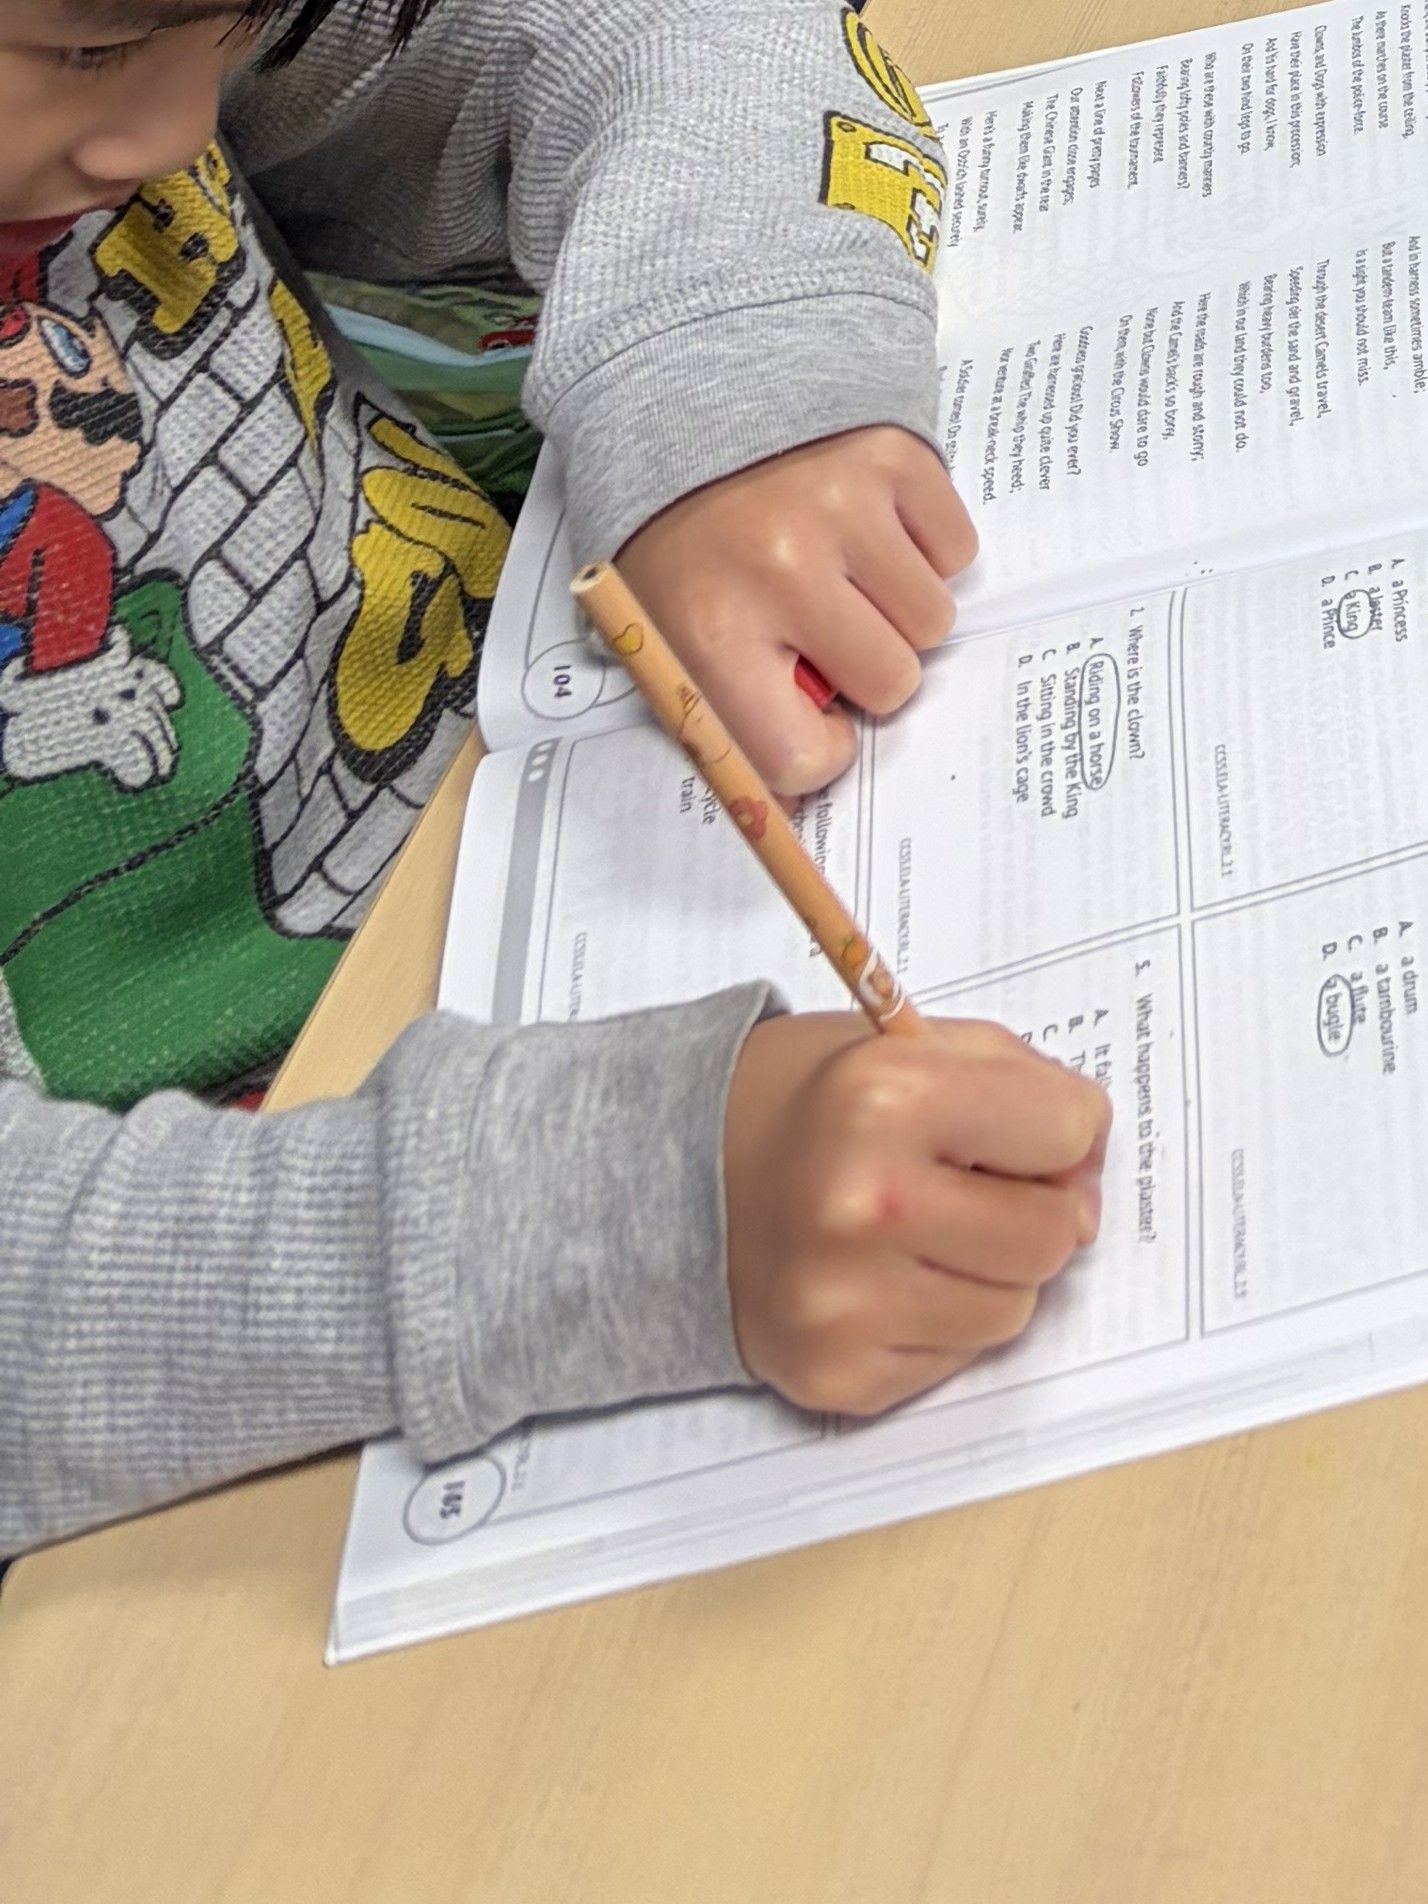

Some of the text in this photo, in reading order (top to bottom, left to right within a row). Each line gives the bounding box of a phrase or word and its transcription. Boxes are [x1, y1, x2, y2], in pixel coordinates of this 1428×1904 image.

[1321, 607, 1339, 649] Prince
[1341, 601, 1361, 634] King
[1391, 588, 1409, 642] Princess
[1126, 624, 1143, 665] Where
[552, 664, 572, 698] 104
[1034, 673, 1055, 721] Sitting
[1059, 666, 1080, 731] Standing
[1083, 660, 1104, 706] Riding
[1127, 680, 1143, 705] the
[1015, 696, 1032, 722] the
[1015, 723, 1033, 765] lion's
[1039, 739, 1056, 767] the
[1128, 708, 1145, 759] clown?
[1012, 766, 1029, 803] cage
[1064, 750, 1081, 779] the
[1086, 741, 1108, 787] horse
[679, 776, 696, 813] train
[1040, 769, 1057, 817] crowd
[1060, 781, 1082, 819] King
[1352, 984, 1369, 1025] flute
[1401, 969, 1419, 1015] drum
[1135, 993, 1153, 1041] What
[1322, 991, 1344, 1042] bugle
[1375, 975, 1396, 1073] tambourine
[1132, 1040, 1154, 1118] happens
[1137, 1140, 1155, 1171] the
[1135, 1175, 1157, 1241] plaster?
